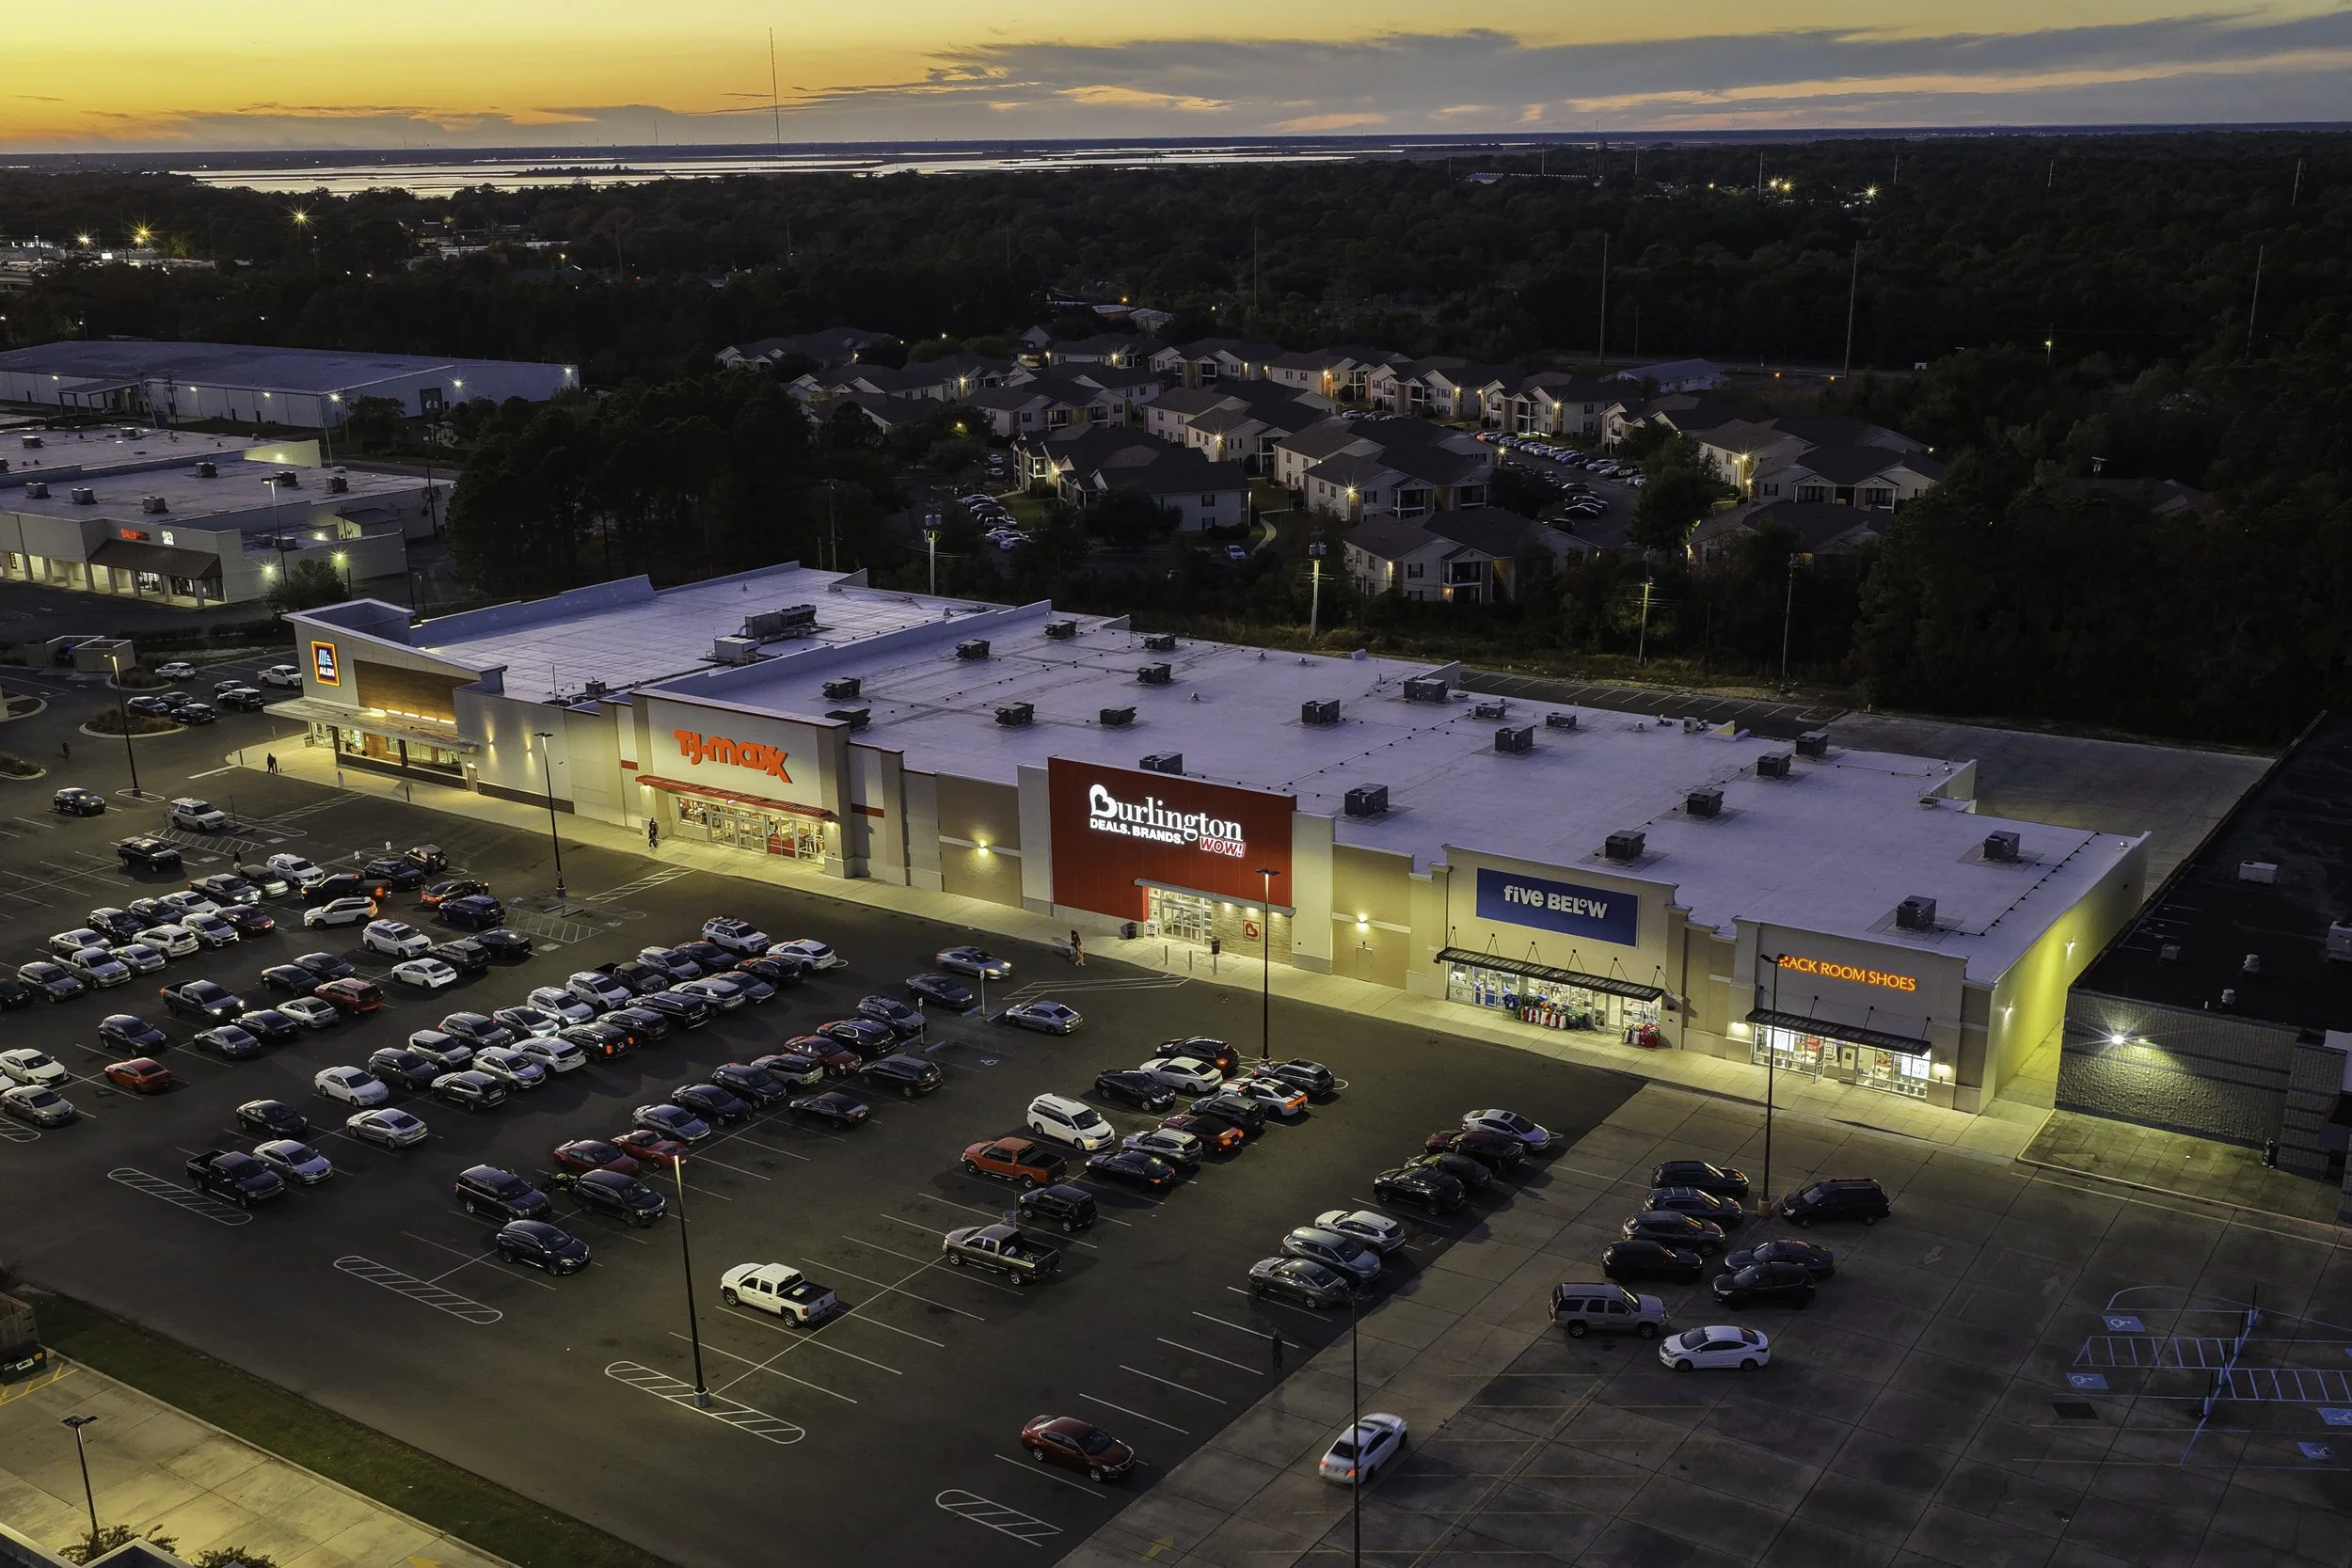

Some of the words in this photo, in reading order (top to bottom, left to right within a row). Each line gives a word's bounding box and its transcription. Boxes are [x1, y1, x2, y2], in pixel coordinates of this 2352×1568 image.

[319, 666, 335, 677] ALDI
[1089, 784, 1244, 842] Burlington
[1089, 817, 1131, 835] DEALS.
[1132, 826, 1185, 846] BRANDS.
[1200, 835, 1246, 858] WOW!
[1503, 885, 1544, 908] five
[1548, 893, 1608, 919] BELOW
[1820, 962, 1866, 982] ROOM
[1868, 971, 1916, 991] SHOES
